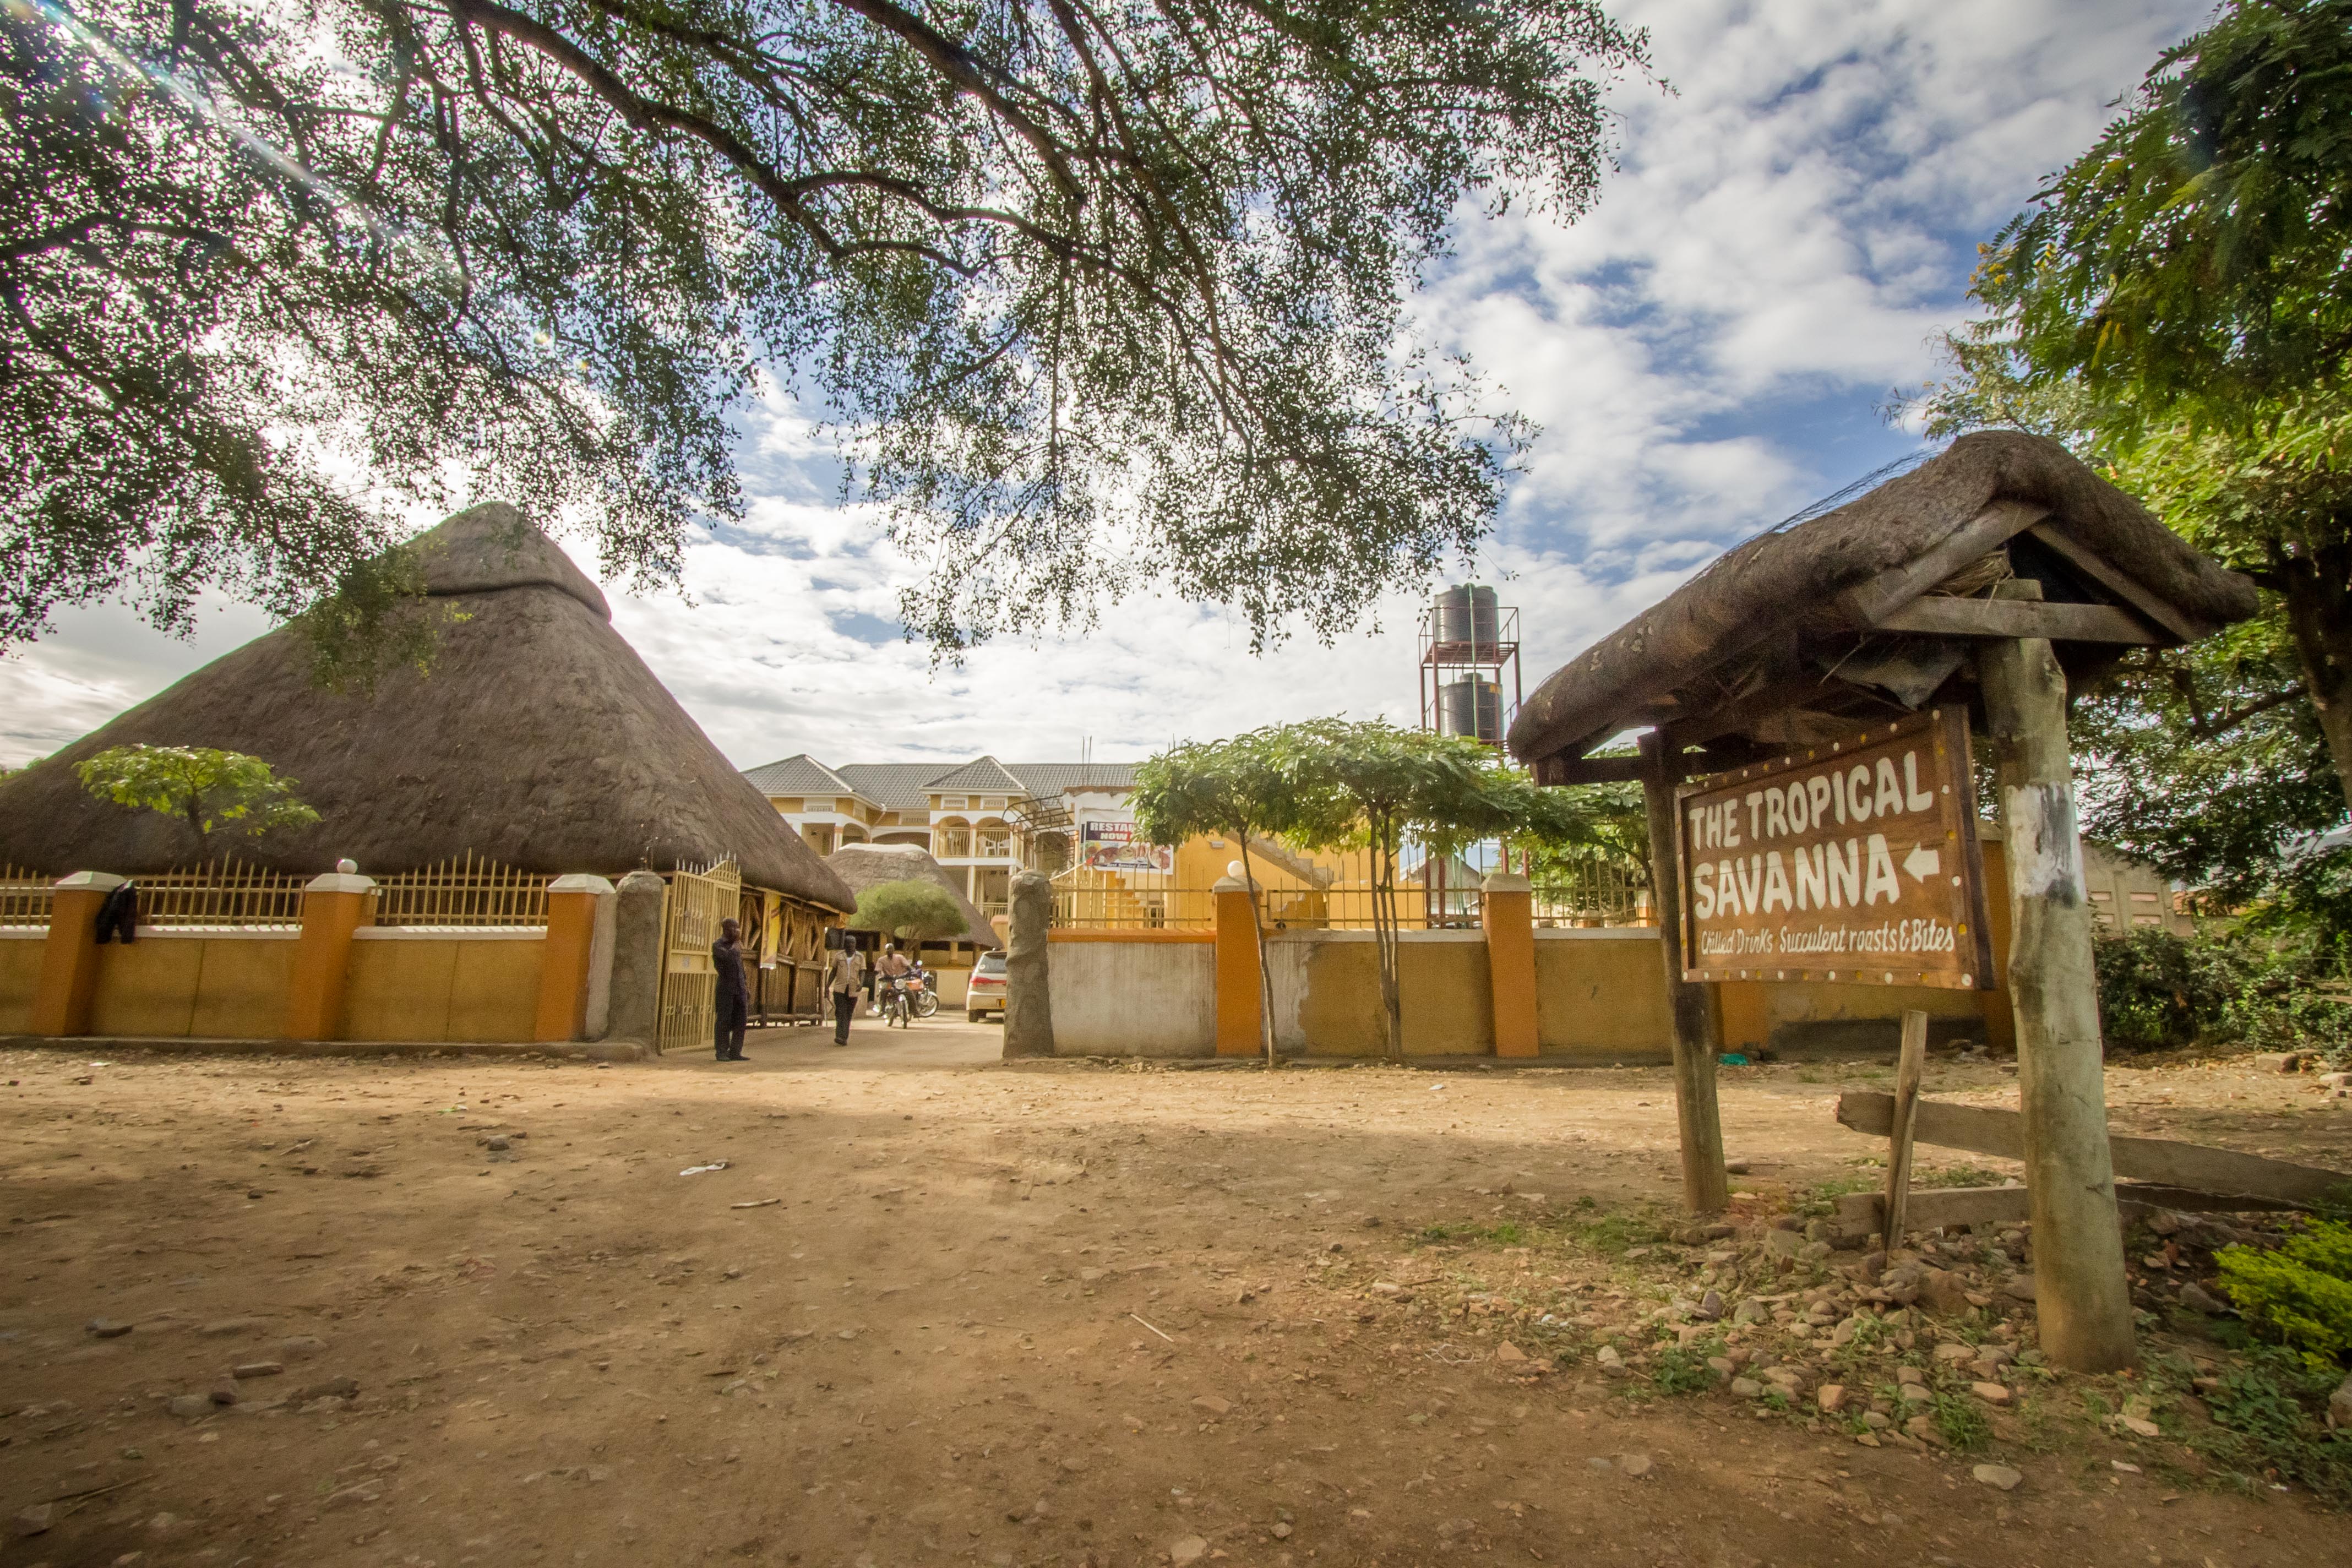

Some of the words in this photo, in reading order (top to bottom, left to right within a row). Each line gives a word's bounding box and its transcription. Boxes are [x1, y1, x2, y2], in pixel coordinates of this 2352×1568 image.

[1689, 799, 1740, 851] THE
[1746, 751, 1933, 841] TROPICAL
[1694, 834, 1900, 919] SAVANNA
[1701, 929, 1735, 955] Chilled
[1780, 924, 1846, 953] Succulent
[1849, 921, 1897, 952] roasts
[1899, 918, 1909, 952] &
[1910, 918, 1954, 952] Bites
